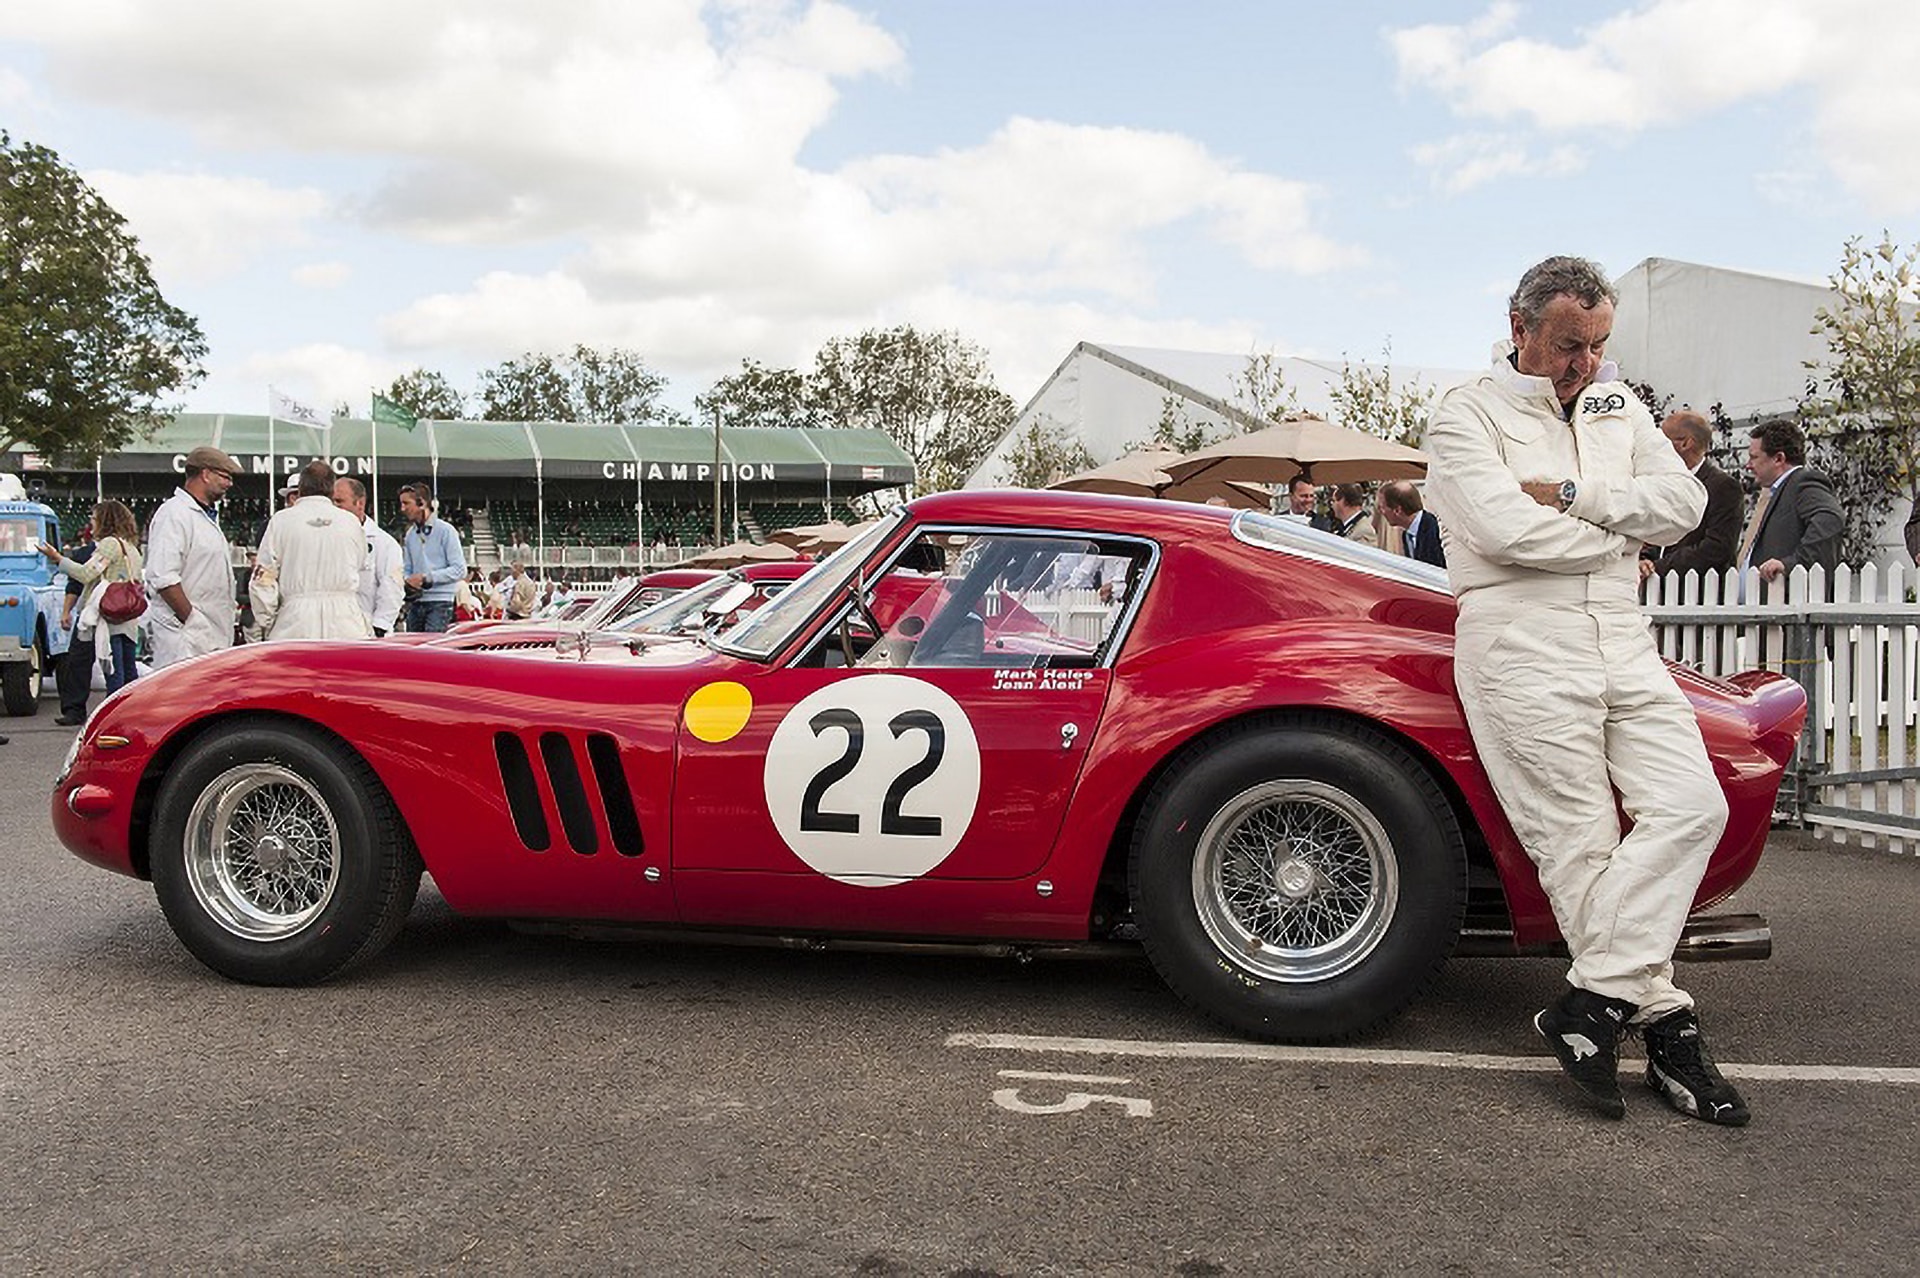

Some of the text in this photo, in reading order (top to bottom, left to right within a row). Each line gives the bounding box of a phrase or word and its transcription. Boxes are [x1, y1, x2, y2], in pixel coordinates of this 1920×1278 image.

[172, 454, 373, 476] CMPON
[602, 461, 776, 481] CHAMPION
[994, 669, 1037, 679] Mark
[800, 707, 946, 837] 22
[992, 1069, 1154, 1118] 15
